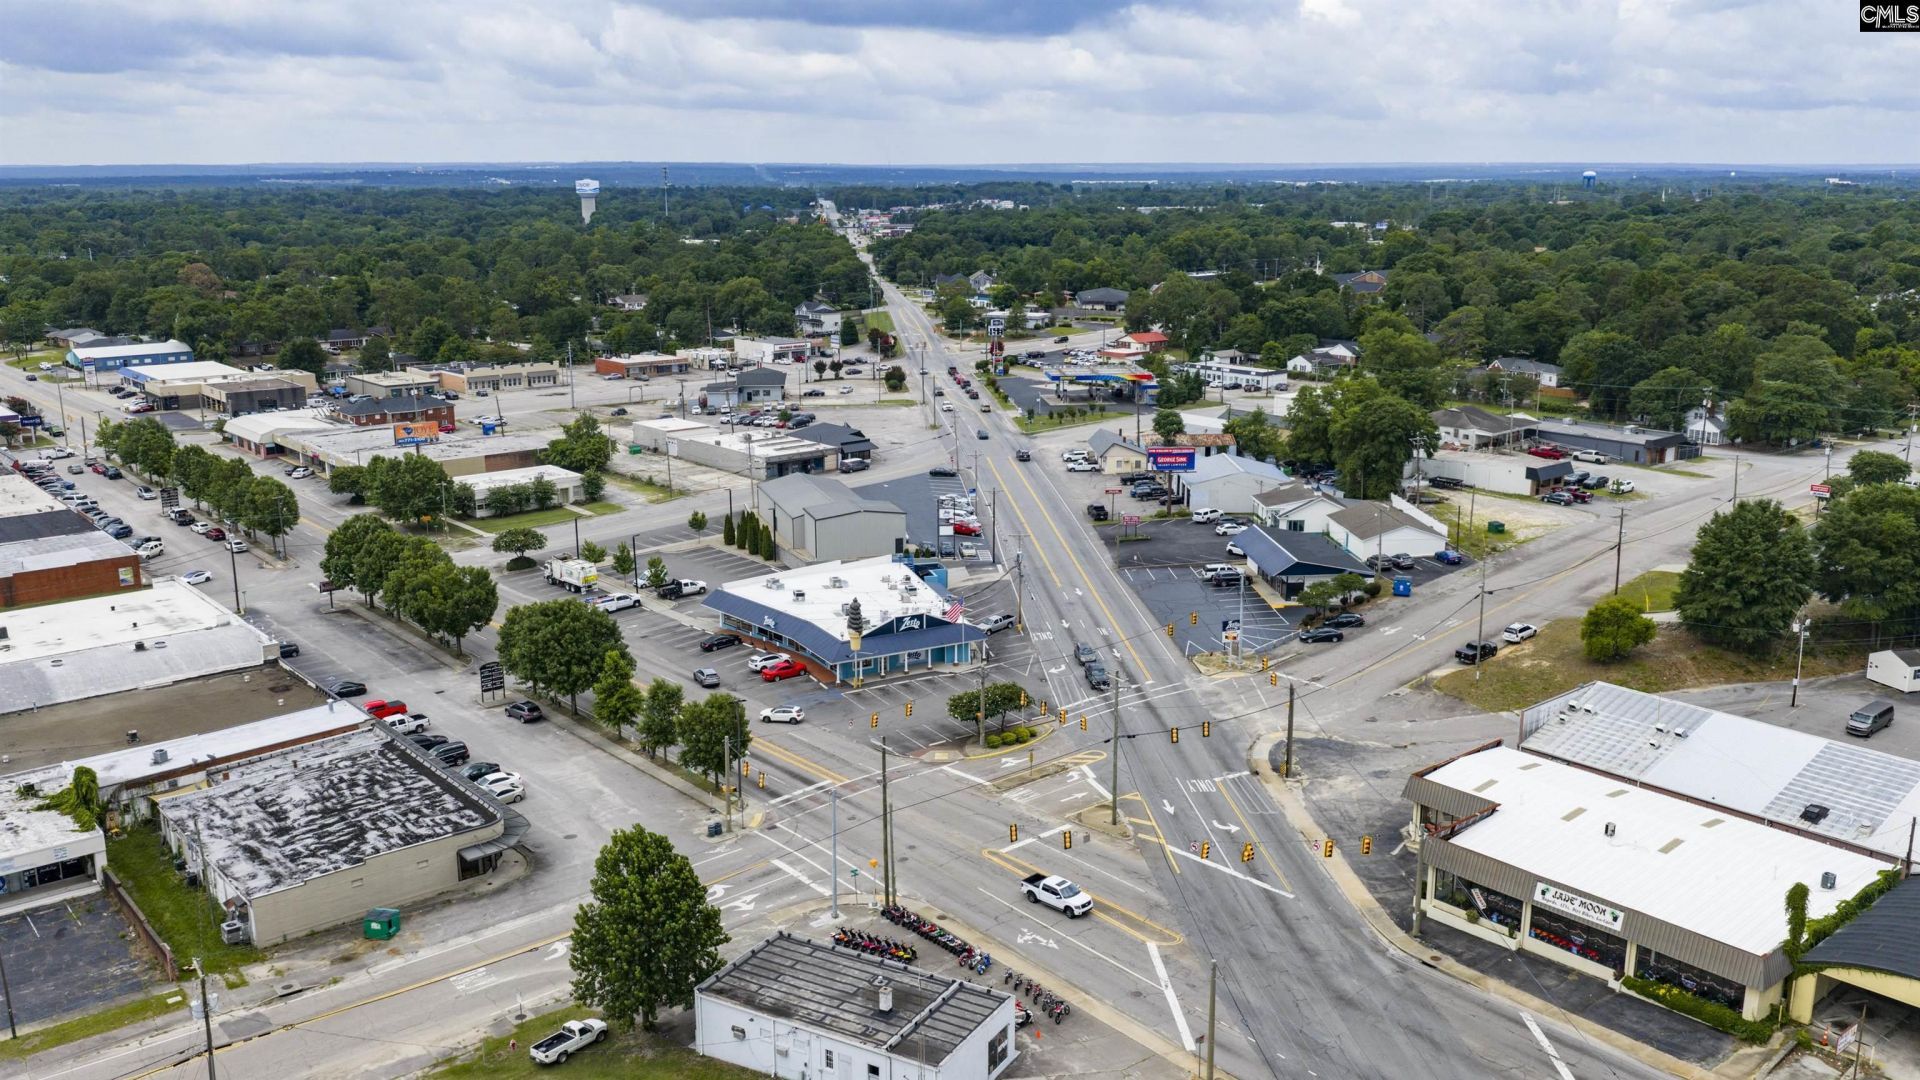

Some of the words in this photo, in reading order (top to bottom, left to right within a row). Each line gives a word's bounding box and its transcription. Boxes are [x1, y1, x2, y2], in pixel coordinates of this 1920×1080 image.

[899, 616, 921, 632] Zesto
[1186, 779, 1216, 793] ONLY
[1552, 890, 1578, 906] JADE
[1579, 899, 1606, 916] MOON
